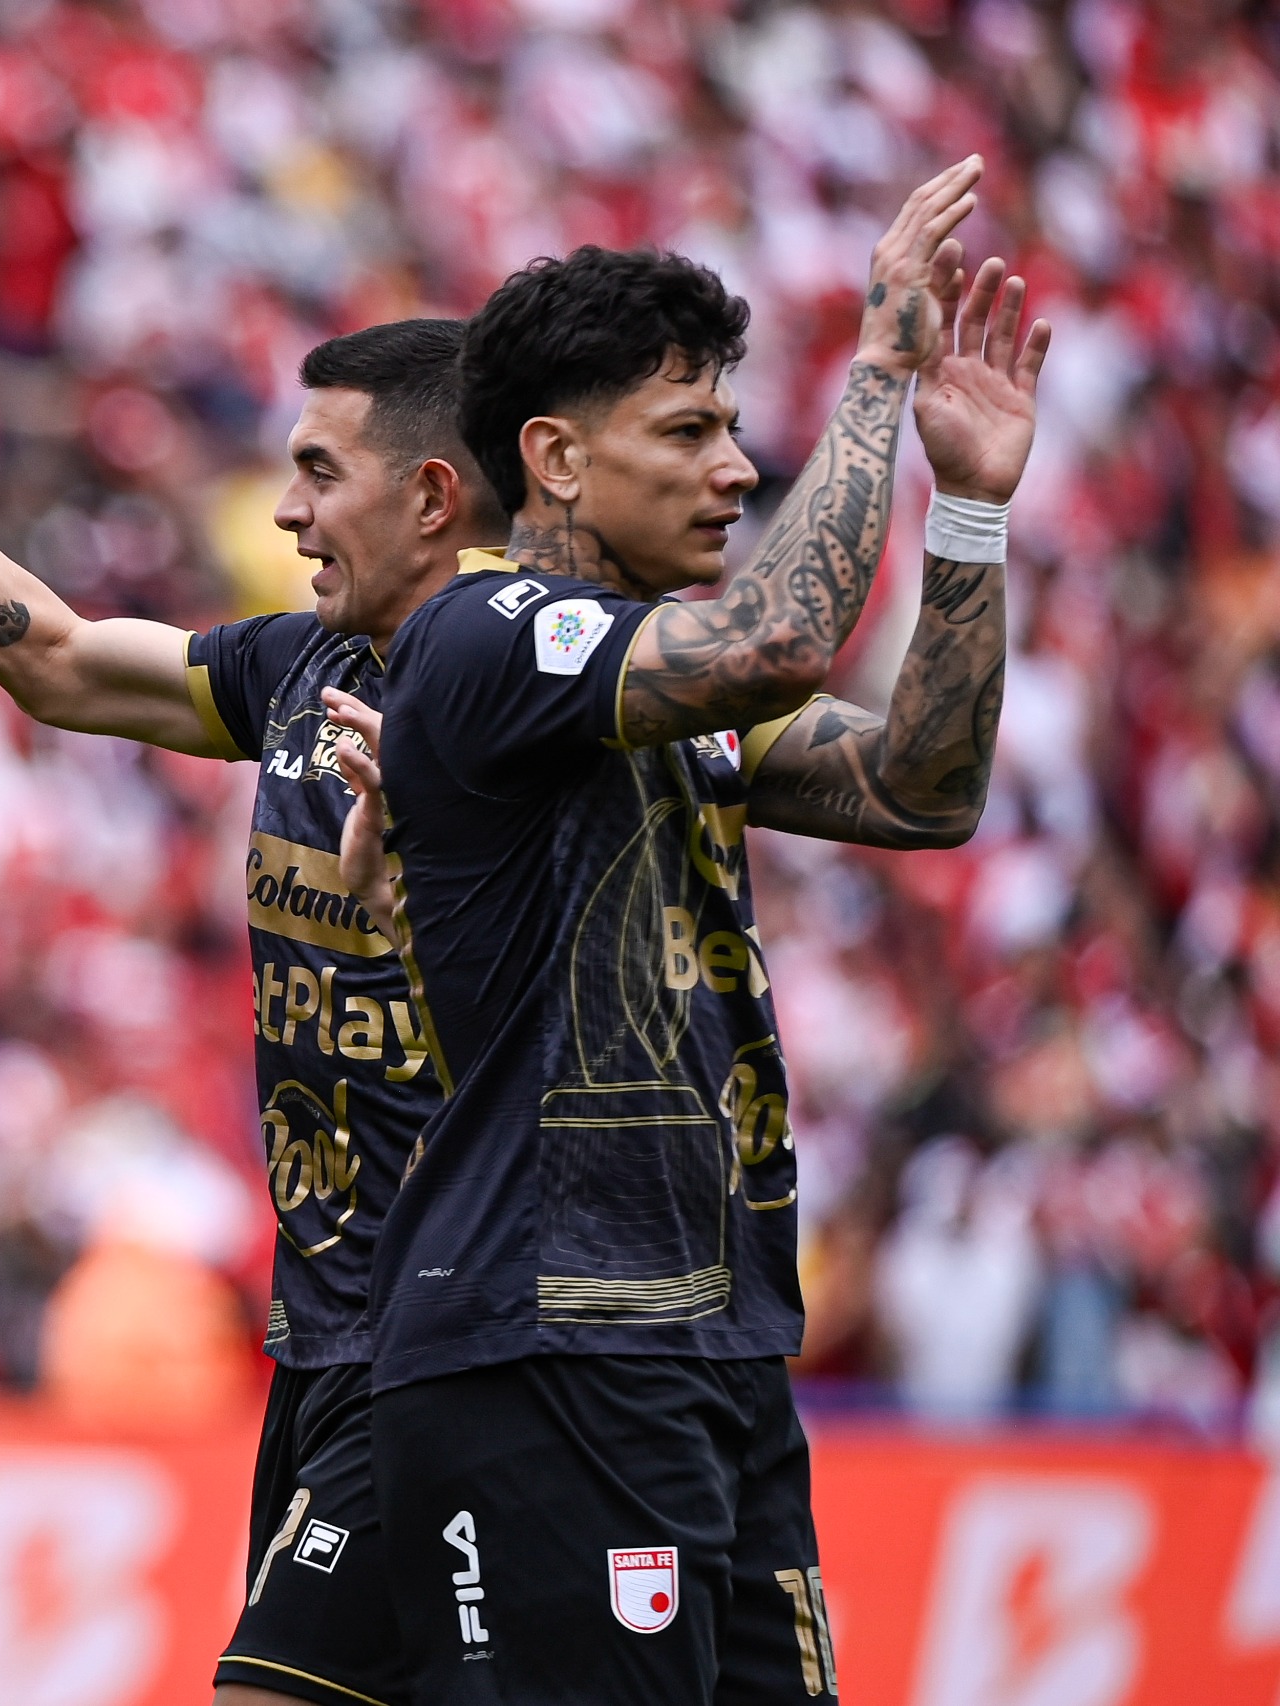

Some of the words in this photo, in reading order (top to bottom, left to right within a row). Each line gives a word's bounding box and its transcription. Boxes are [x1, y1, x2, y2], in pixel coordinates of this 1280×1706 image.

[266, 749, 303, 780] FILA
[615, 1554, 654, 1568] SANTA
[657, 1553, 672, 1567] FE
[442, 1510, 489, 1644] FILA
